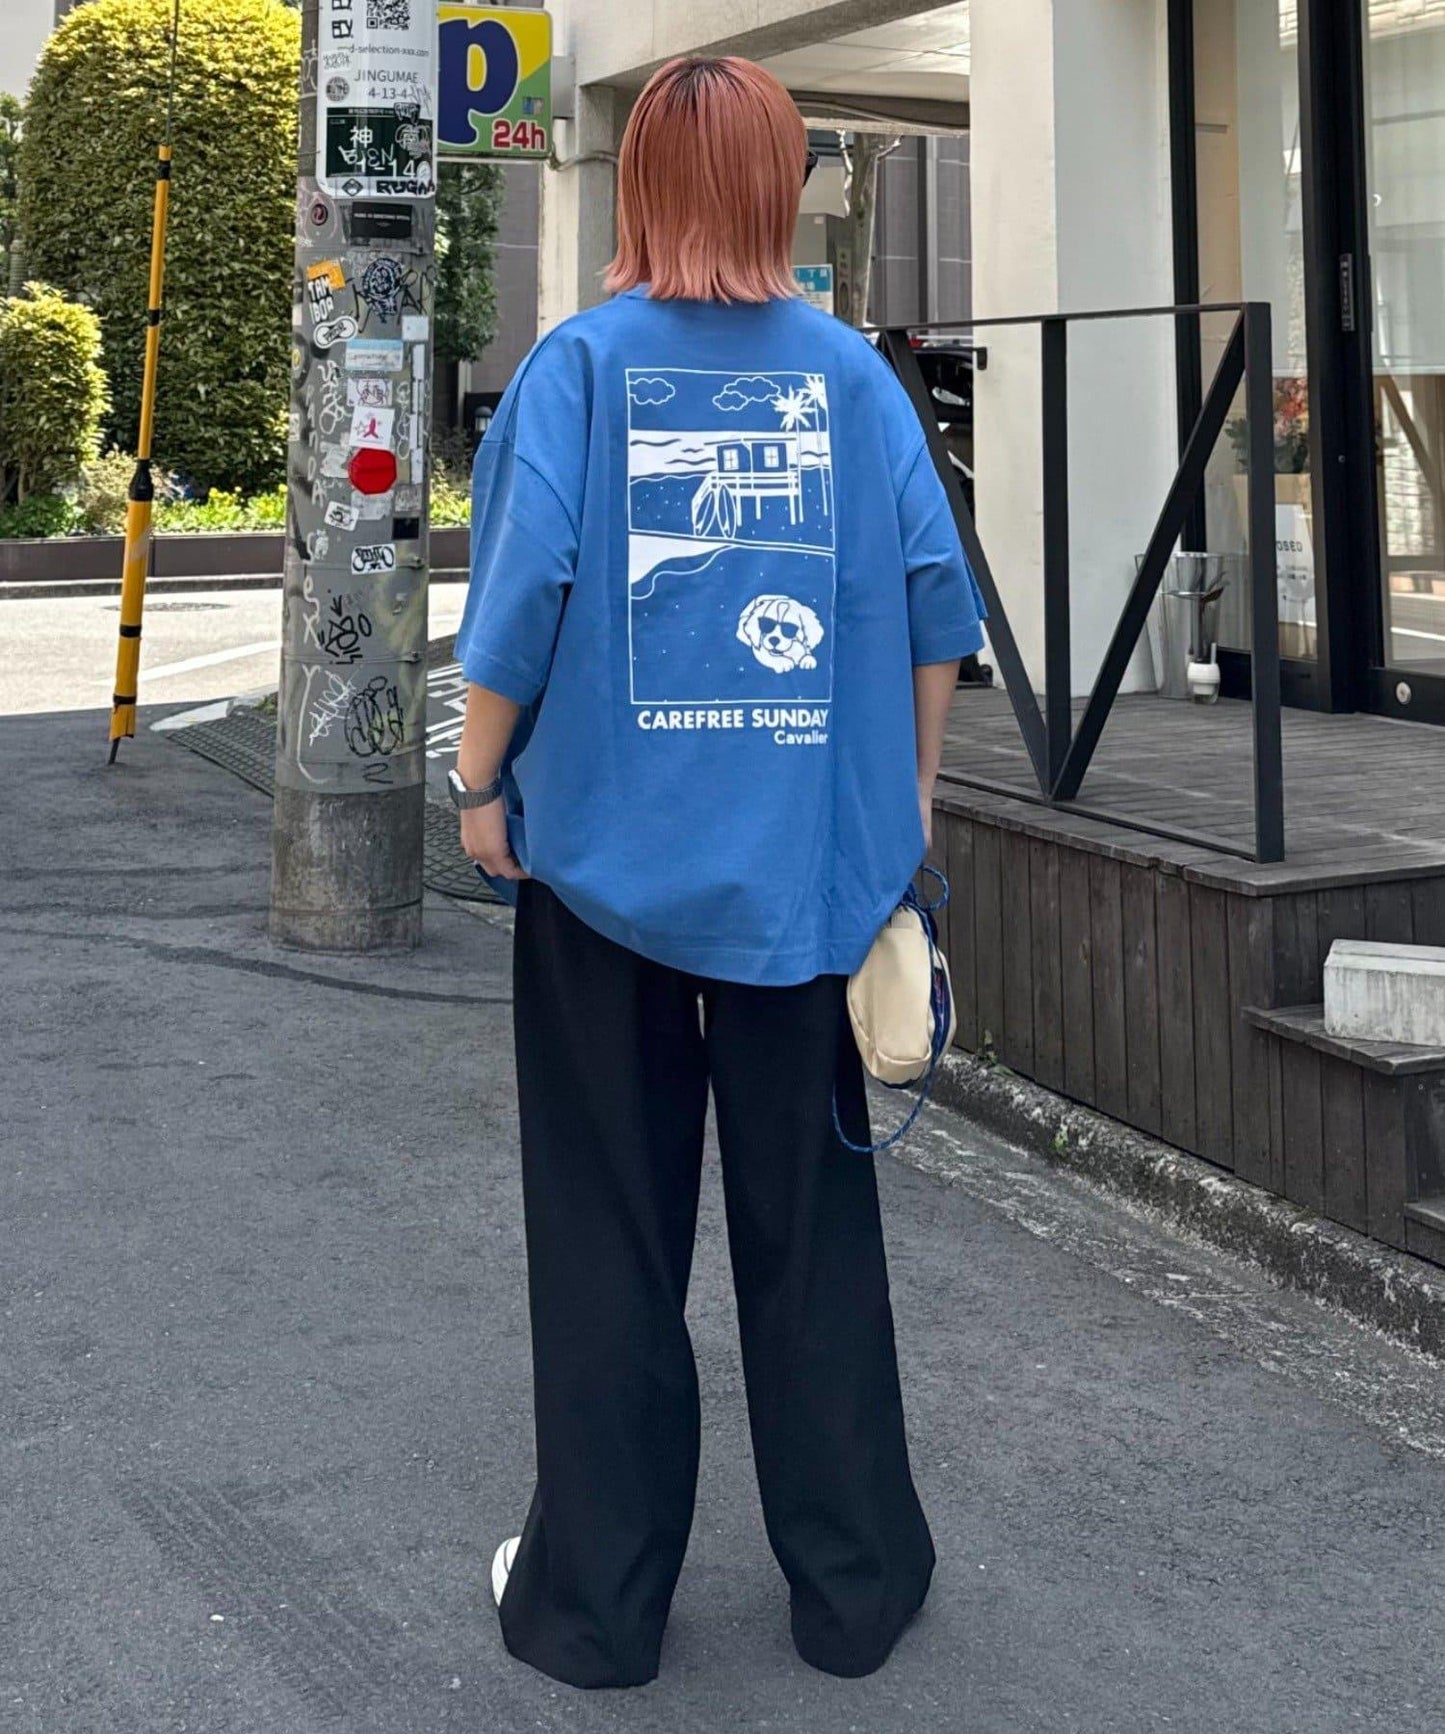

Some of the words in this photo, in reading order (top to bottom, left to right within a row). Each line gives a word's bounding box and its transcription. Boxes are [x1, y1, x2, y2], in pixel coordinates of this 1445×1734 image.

[354, 69, 419, 83] JINGUMAE
[492, 118, 546, 151] 24h
[637, 709, 744, 729] CAREFREE
[751, 708, 829, 728] SUNDAY
[774, 730, 828, 745] Cavalier
